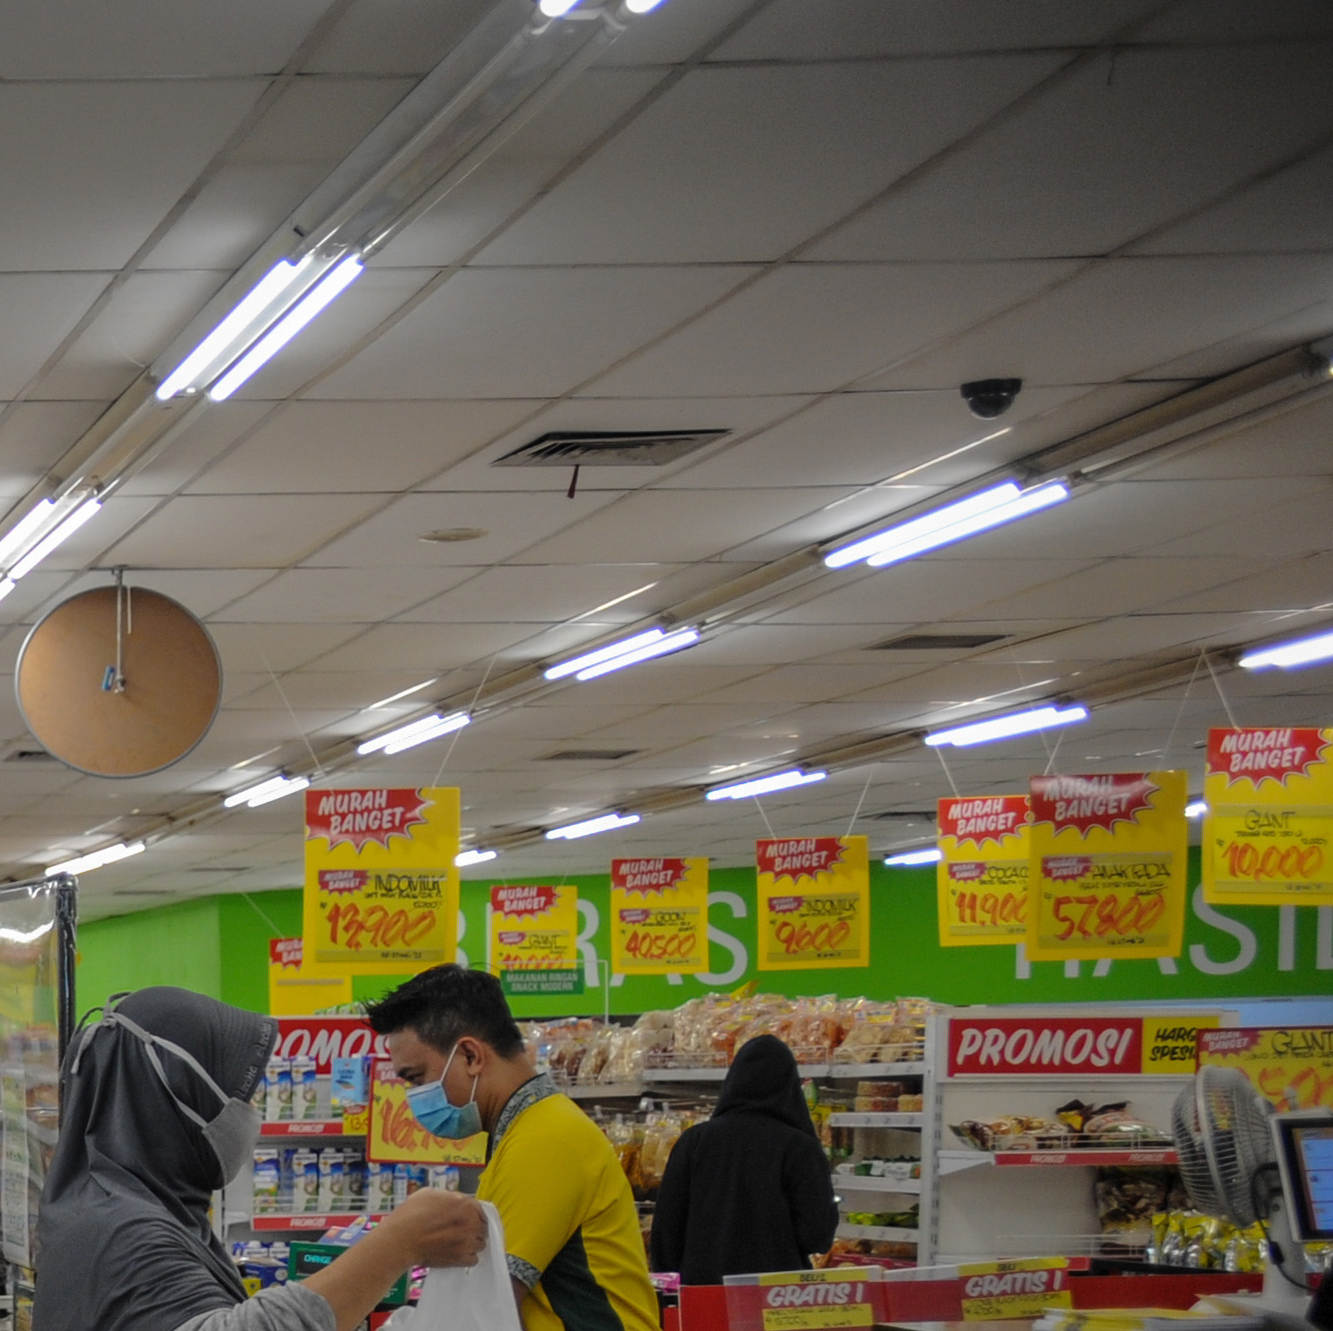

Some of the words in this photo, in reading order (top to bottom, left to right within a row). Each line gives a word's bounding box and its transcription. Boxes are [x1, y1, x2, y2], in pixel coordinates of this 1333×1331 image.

[1219, 730, 1292, 754] MURAH
[1230, 747, 1306, 772] BANGET
[1044, 776, 1114, 800] MURAH
[319, 790, 388, 815] MURAH
[948, 799, 1004, 820] MURAH
[1055, 795, 1131, 821] BANGET
[330, 808, 405, 834] BANGET
[956, 812, 1017, 835] BANGET
[766, 839, 816, 858] MURAH
[619, 860, 663, 876] MURAH
[773, 851, 829, 871] BANGET
[626, 871, 673, 887] BANGET
[498, 887, 537, 899] MURAH
[504, 897, 546, 911] BANGET
[540, 981, 574, 991] MODERN
[956, 1028, 1133, 1067] PROMOSI
[767, 1283, 851, 1307] GRATIS
[965, 1272, 1048, 1297] GRATIS
